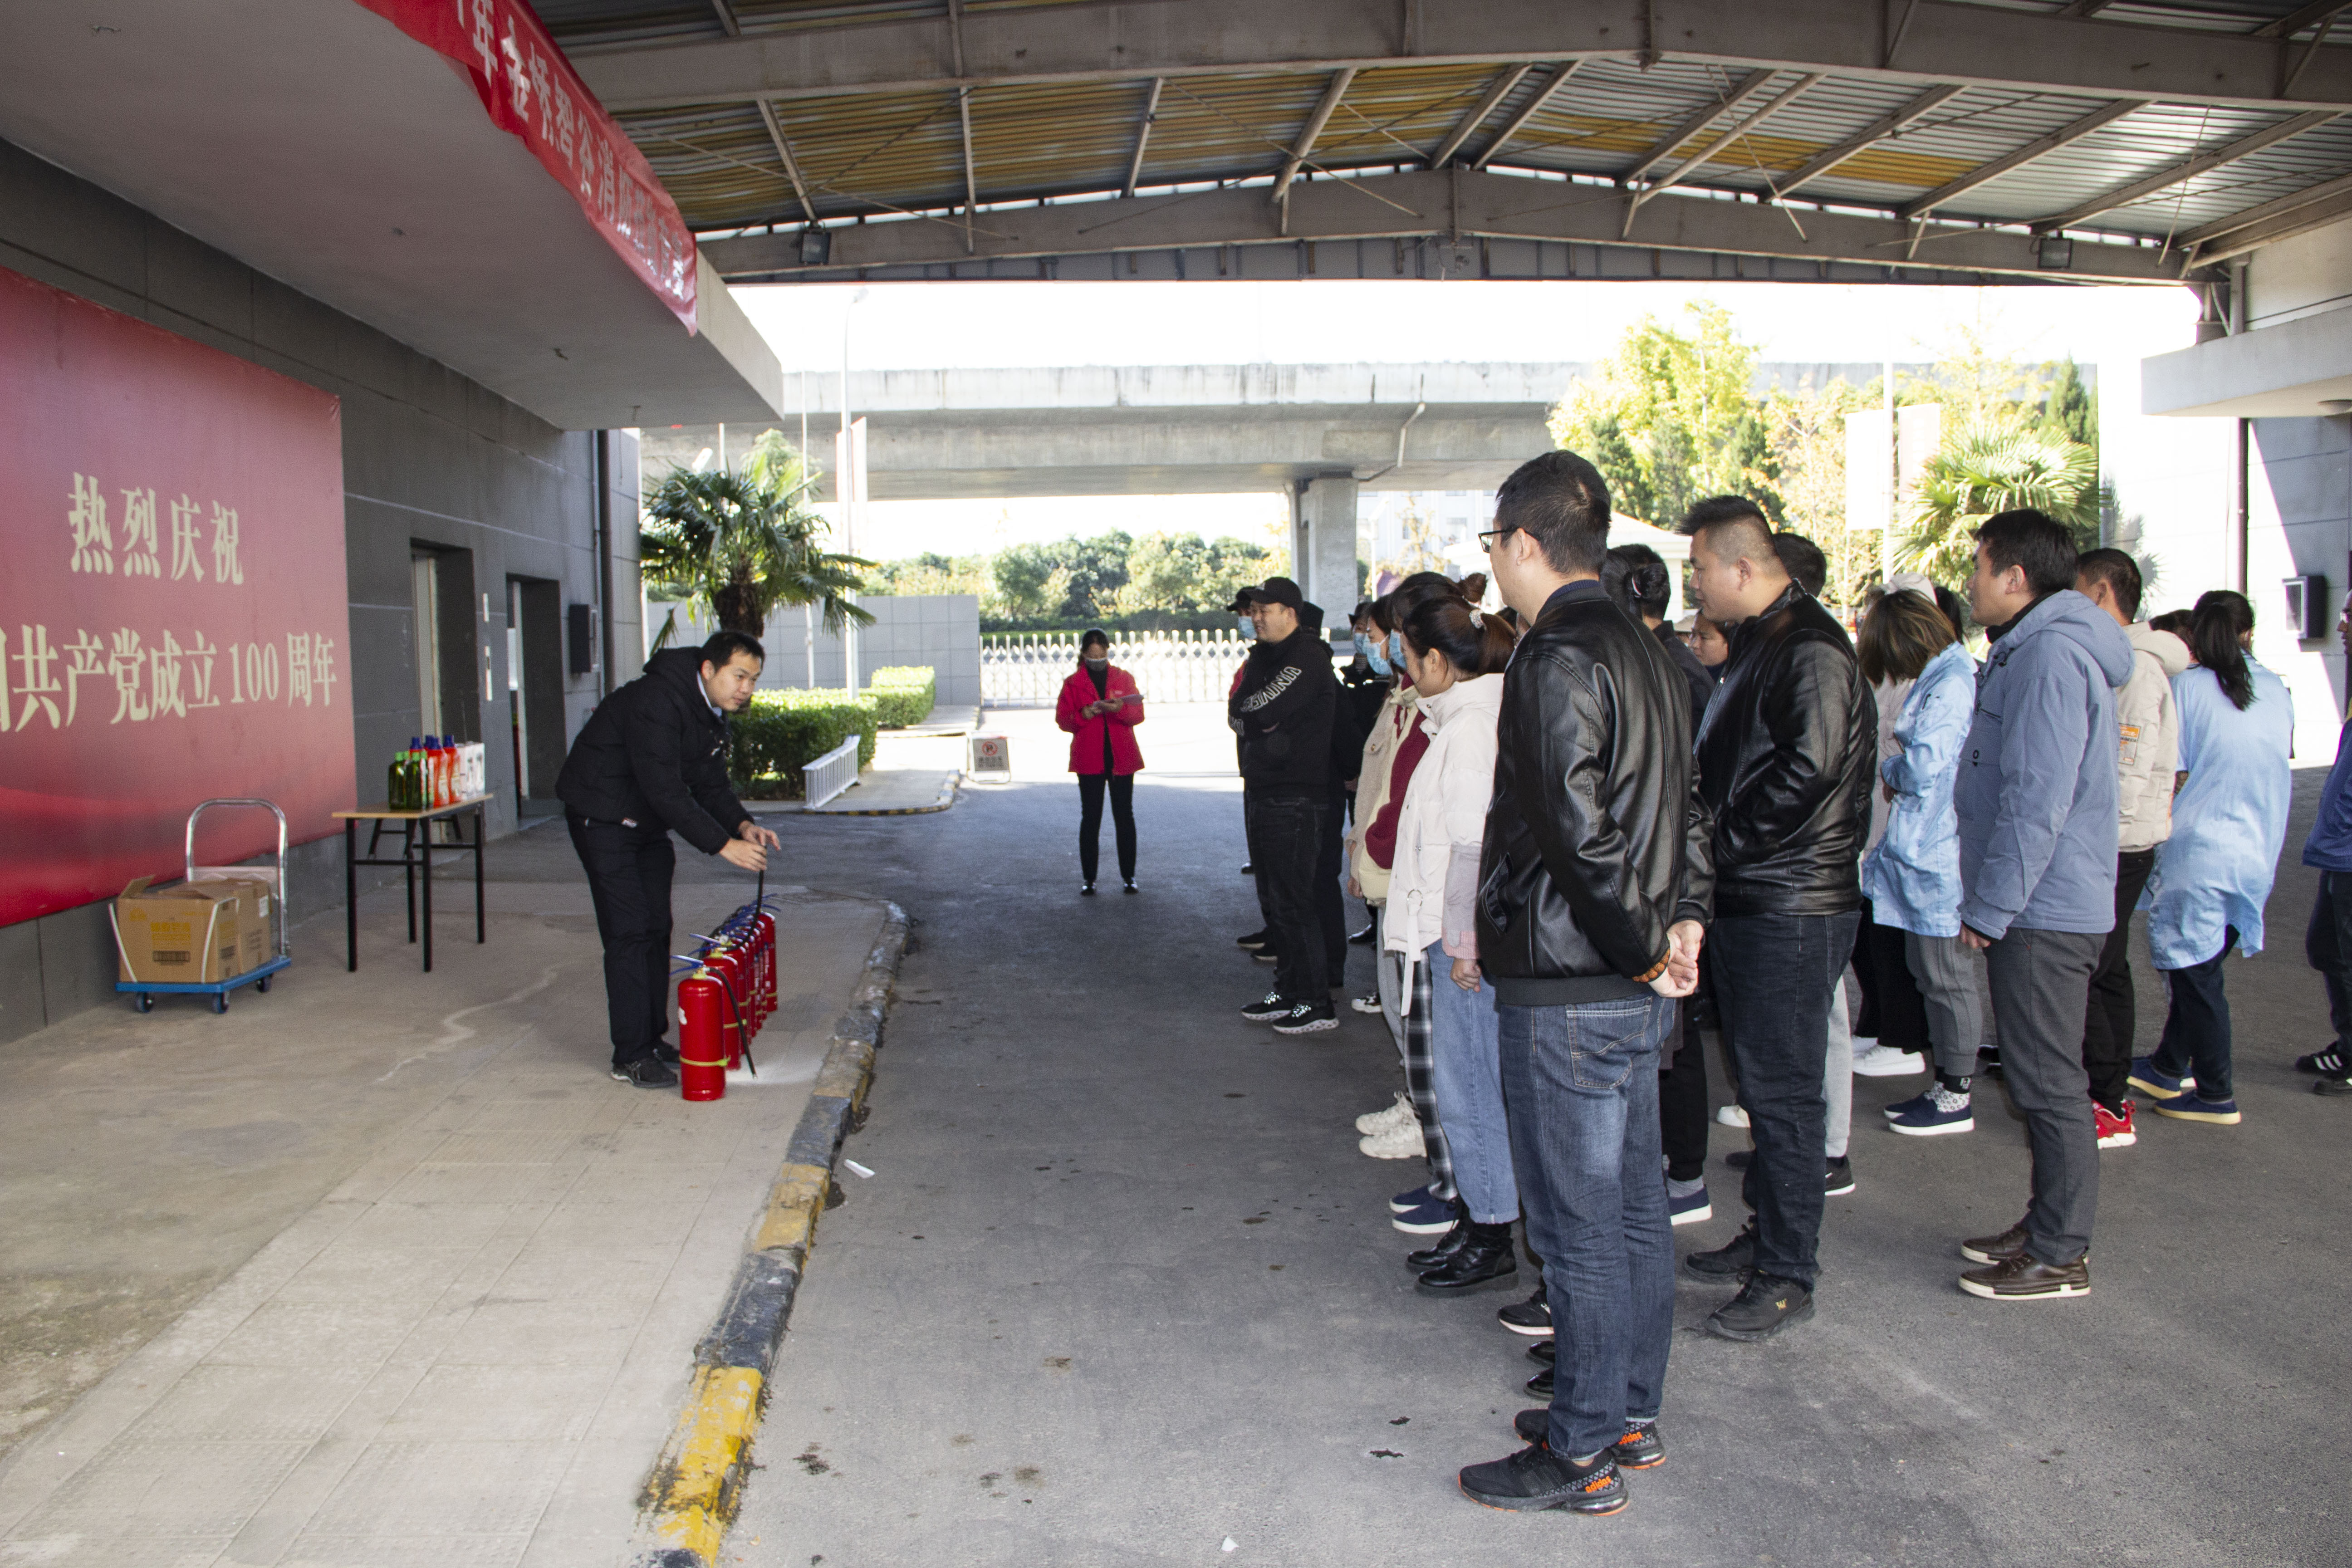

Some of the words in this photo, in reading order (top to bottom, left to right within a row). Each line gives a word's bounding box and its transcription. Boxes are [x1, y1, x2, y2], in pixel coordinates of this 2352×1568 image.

[68, 472, 244, 585] 热烈庆祝
[0, 624, 338, 732] 共产党成立100周年
[1585, 1475, 1612, 1493] adidas
